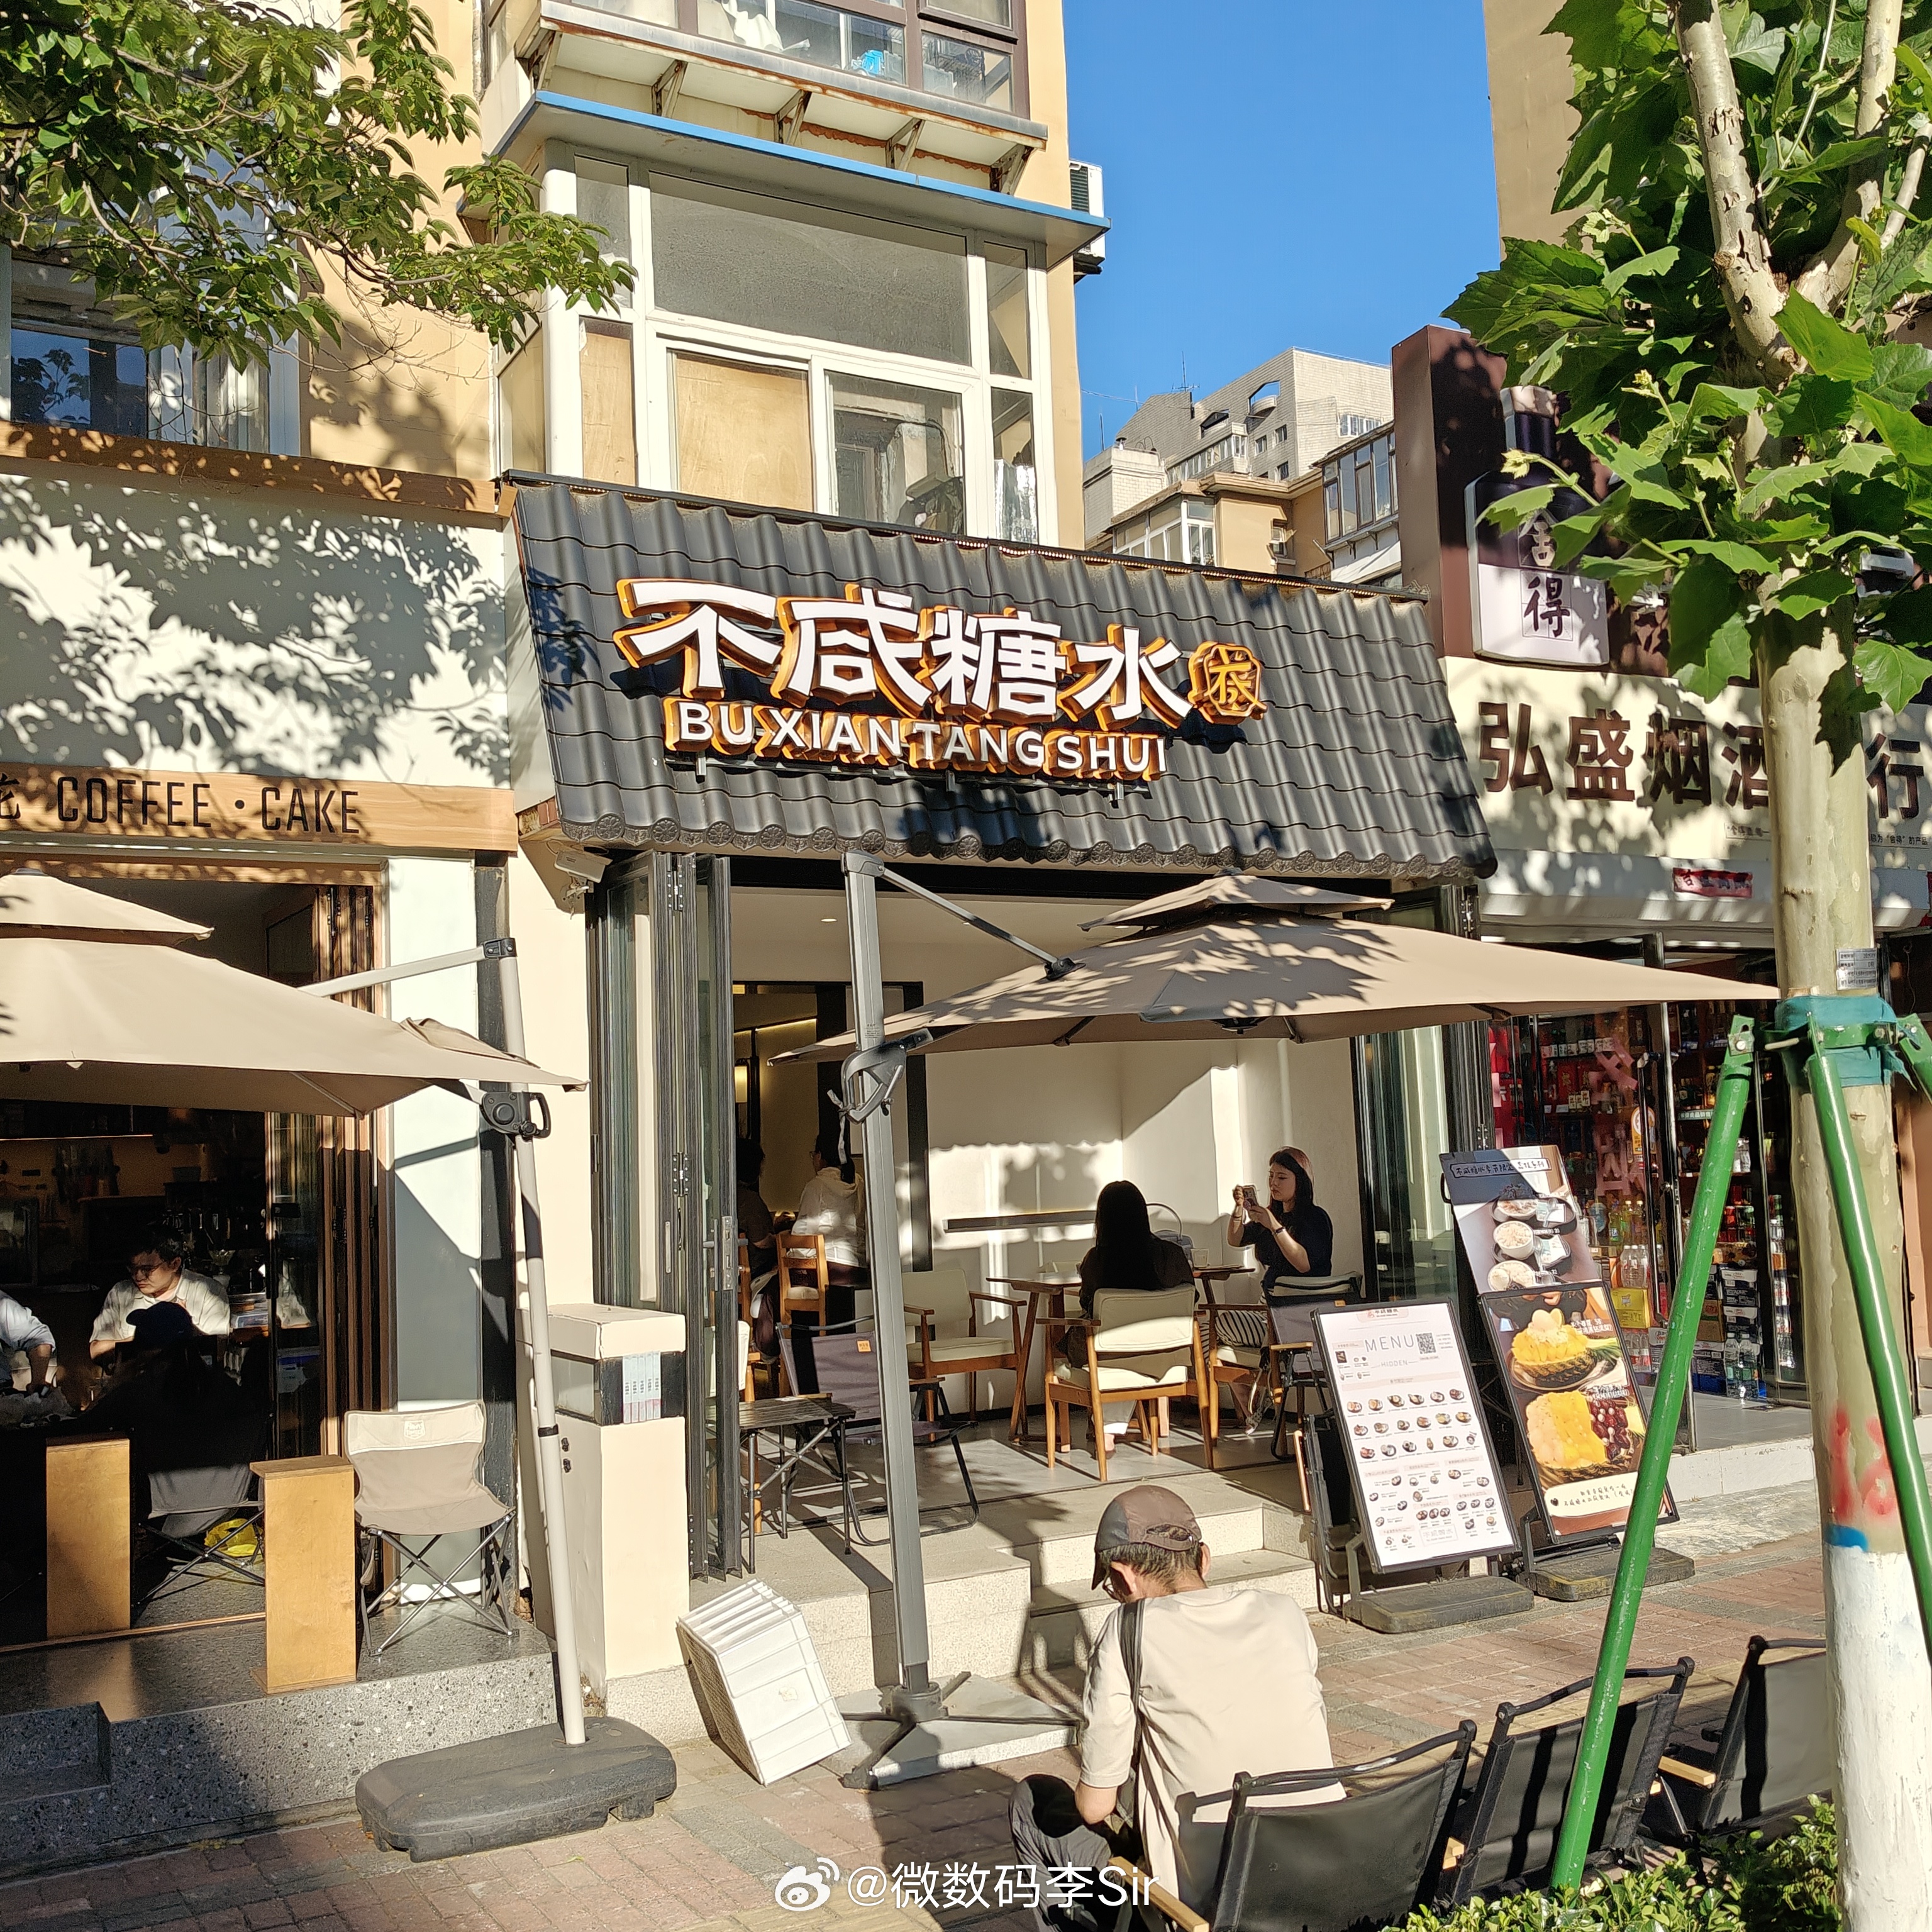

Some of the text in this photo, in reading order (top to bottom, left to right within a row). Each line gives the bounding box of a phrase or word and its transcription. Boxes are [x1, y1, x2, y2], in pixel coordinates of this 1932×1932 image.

[623, 579, 1192, 729] 不咸糖水
[678, 701, 753, 745] BU
[1478, 701, 1924, 819] 弘盛烟酒行
[57, 775, 211, 828] COFFEE
[261, 786, 359, 835] CAKE
[1365, 1334, 1414, 1352] MENU
